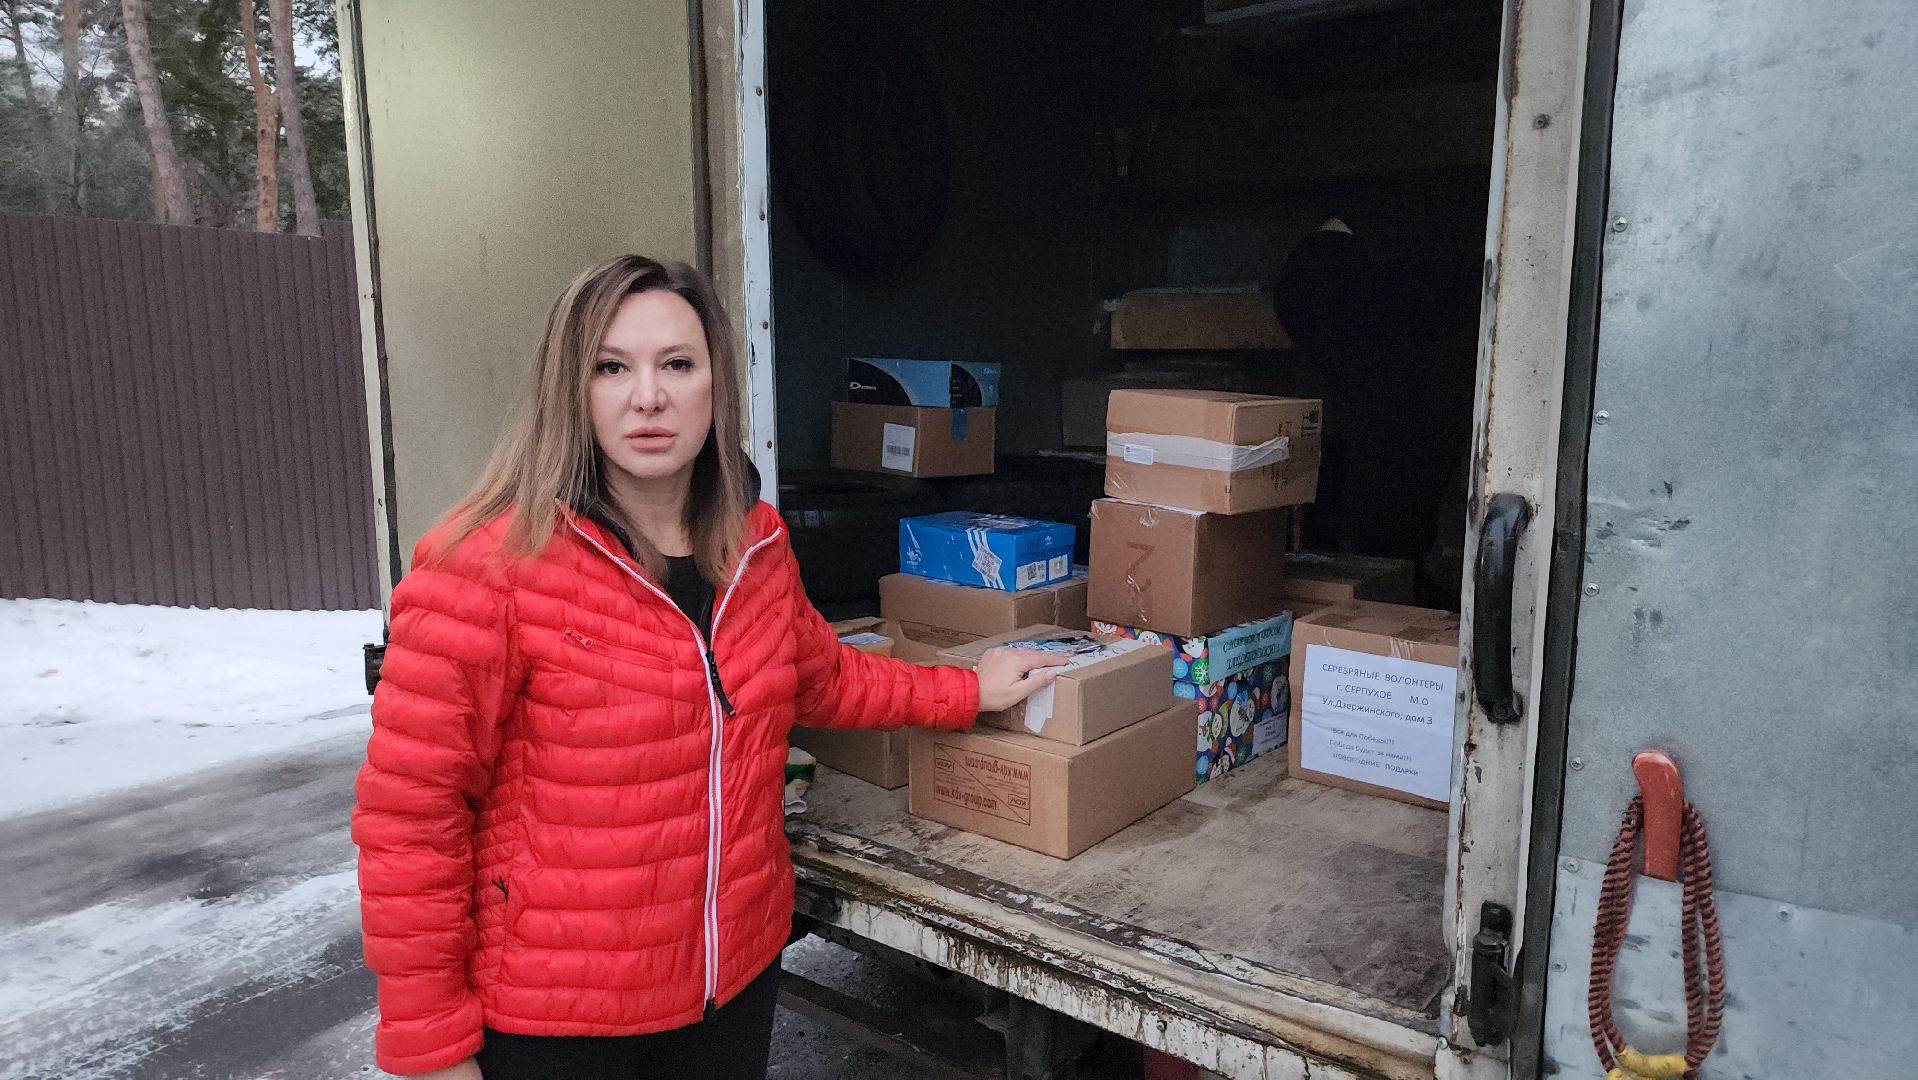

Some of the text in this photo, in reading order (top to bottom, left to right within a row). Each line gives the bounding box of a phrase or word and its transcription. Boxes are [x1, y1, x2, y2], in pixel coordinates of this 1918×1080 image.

[1322, 664, 1444, 691] СЕРЕБРЯНЫЕ ВОЛОНТЕРЫ
[1345, 684, 1392, 700] СЕРПУХОВ
[1405, 714, 1425, 724] дом
[1426, 716, 1433, 725] 3
[1333, 753, 1419, 777] НОВОГОДНИЕ ПОДАРКИ
